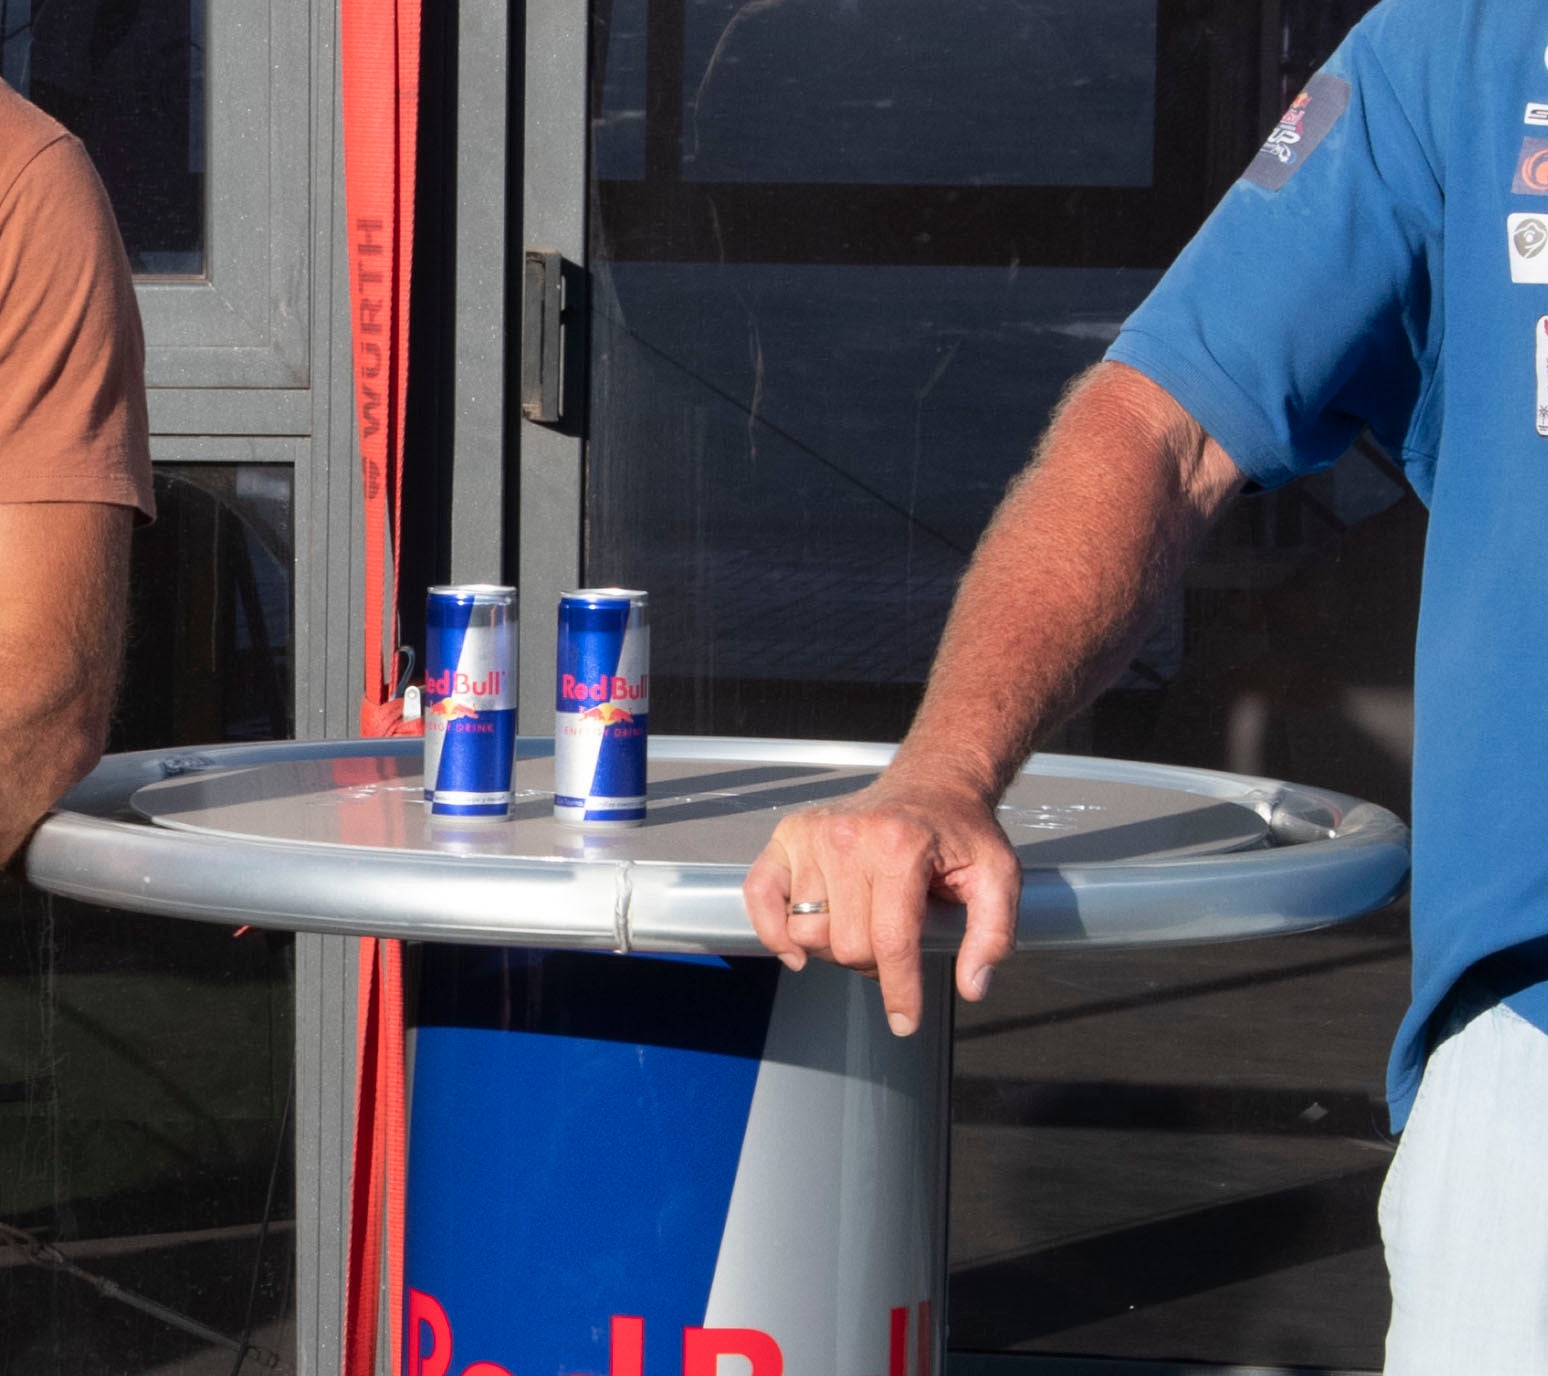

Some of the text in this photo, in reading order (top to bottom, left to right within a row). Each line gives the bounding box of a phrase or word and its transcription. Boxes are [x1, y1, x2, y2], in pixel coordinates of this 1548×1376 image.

[425, 669, 501, 696] ed Bull
[562, 673, 648, 700] Red Bull
